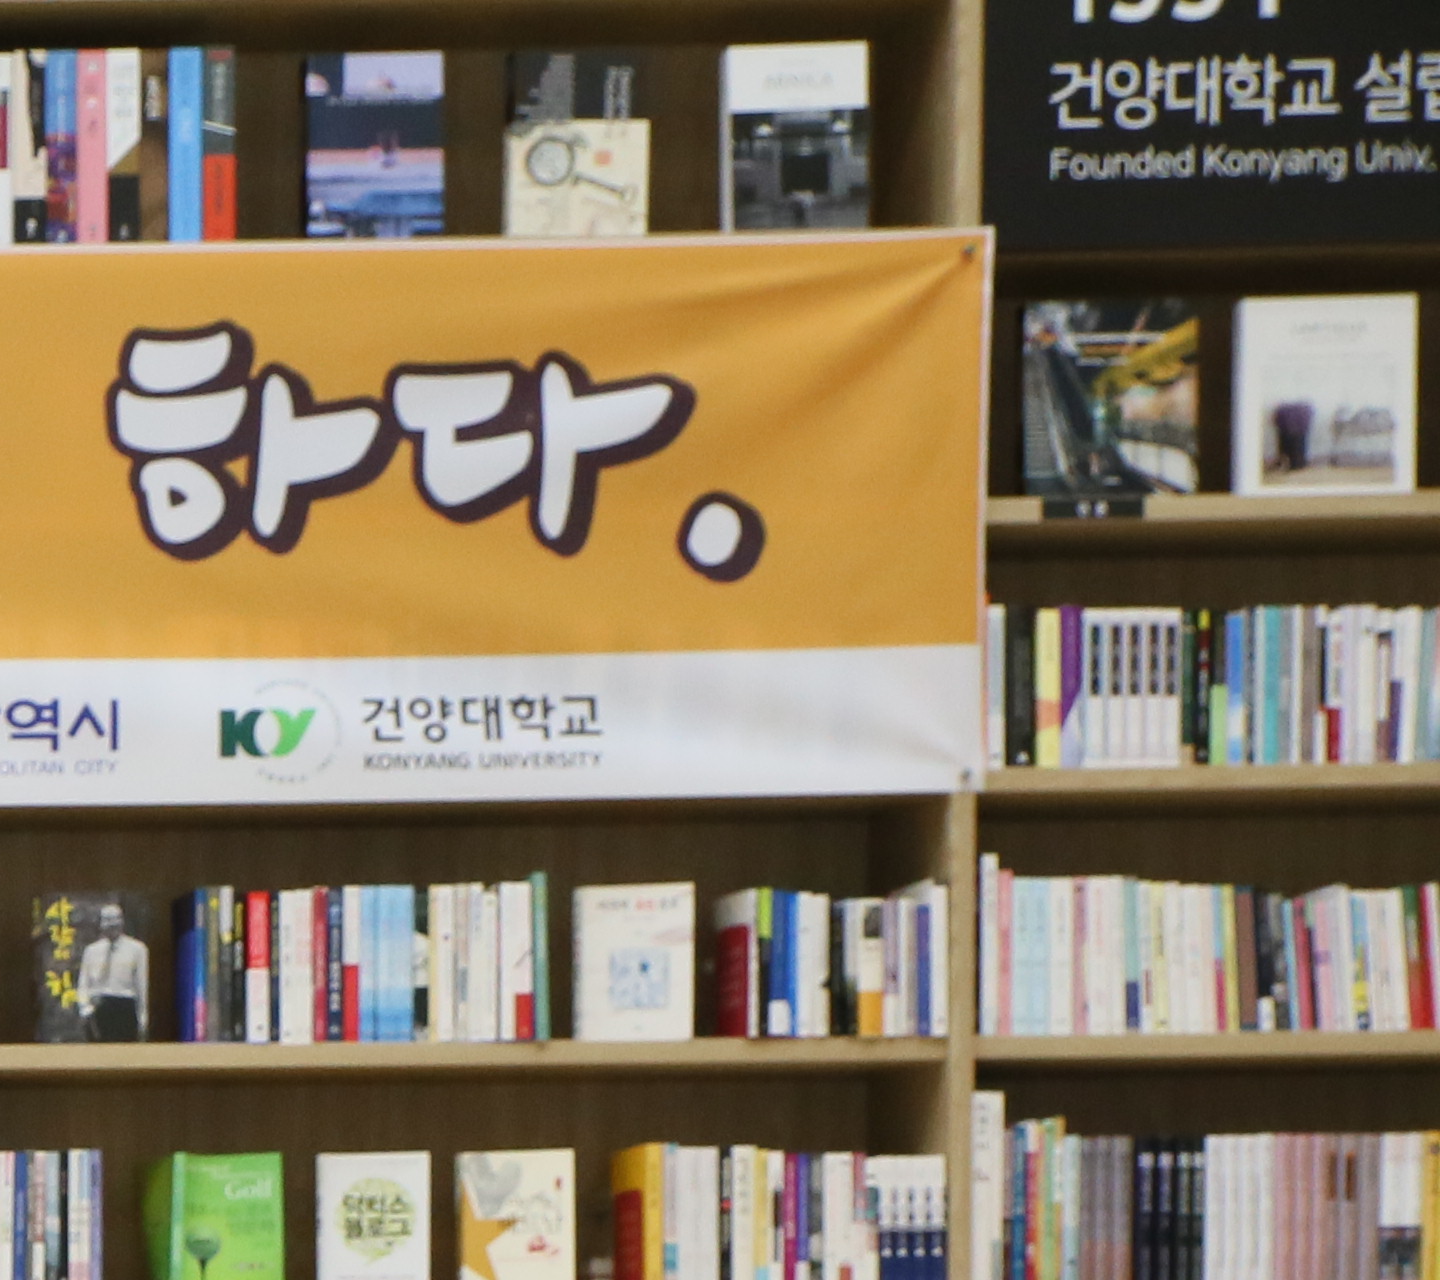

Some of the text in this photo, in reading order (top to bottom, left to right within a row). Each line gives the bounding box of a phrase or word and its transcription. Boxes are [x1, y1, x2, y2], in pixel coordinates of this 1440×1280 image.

[1048, 53, 1344, 130] 건양대학교
[1049, 136, 1439, 184] Founded Konyang Univ.
[107, 321, 766, 583] 하다.
[362, 694, 603, 744] 건양대학교
[73, 759, 119, 776] CITY
[363, 750, 603, 771] KONYANG UNIVERSITY
